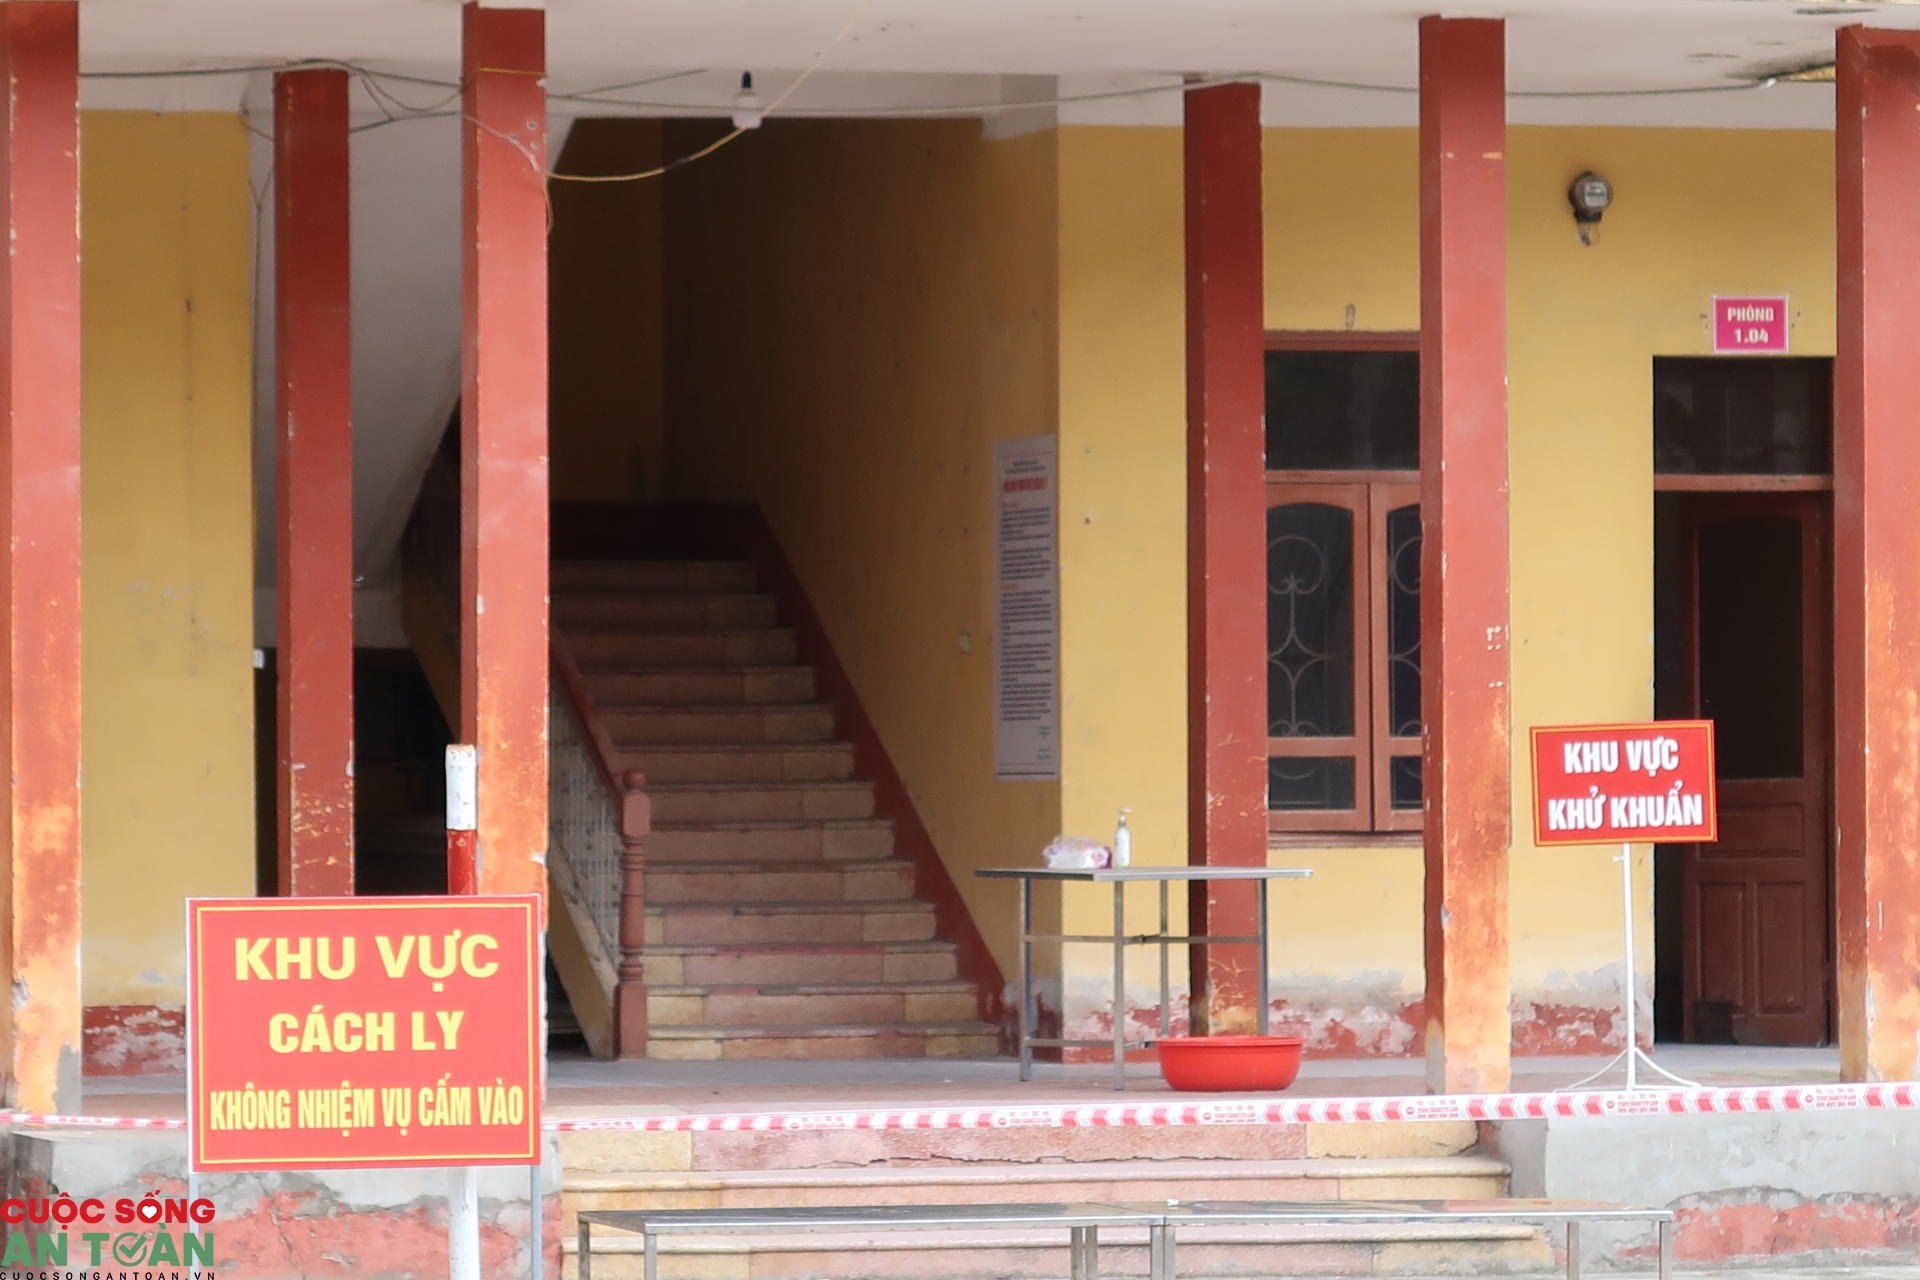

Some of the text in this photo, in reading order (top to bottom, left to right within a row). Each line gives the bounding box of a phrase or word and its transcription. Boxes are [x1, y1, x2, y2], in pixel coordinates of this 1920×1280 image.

[1734, 328, 1769, 344] 1.04
[1563, 736, 1679, 778] KHU VỰC
[1547, 779, 1704, 832] KHỬ KHUẨN
[234, 929, 499, 993] KHU VỰC
[268, 1004, 465, 1054] CÁCH LY
[210, 1073, 524, 1137] KHÔNG NHIỆM VỤ CẤM VÀO
